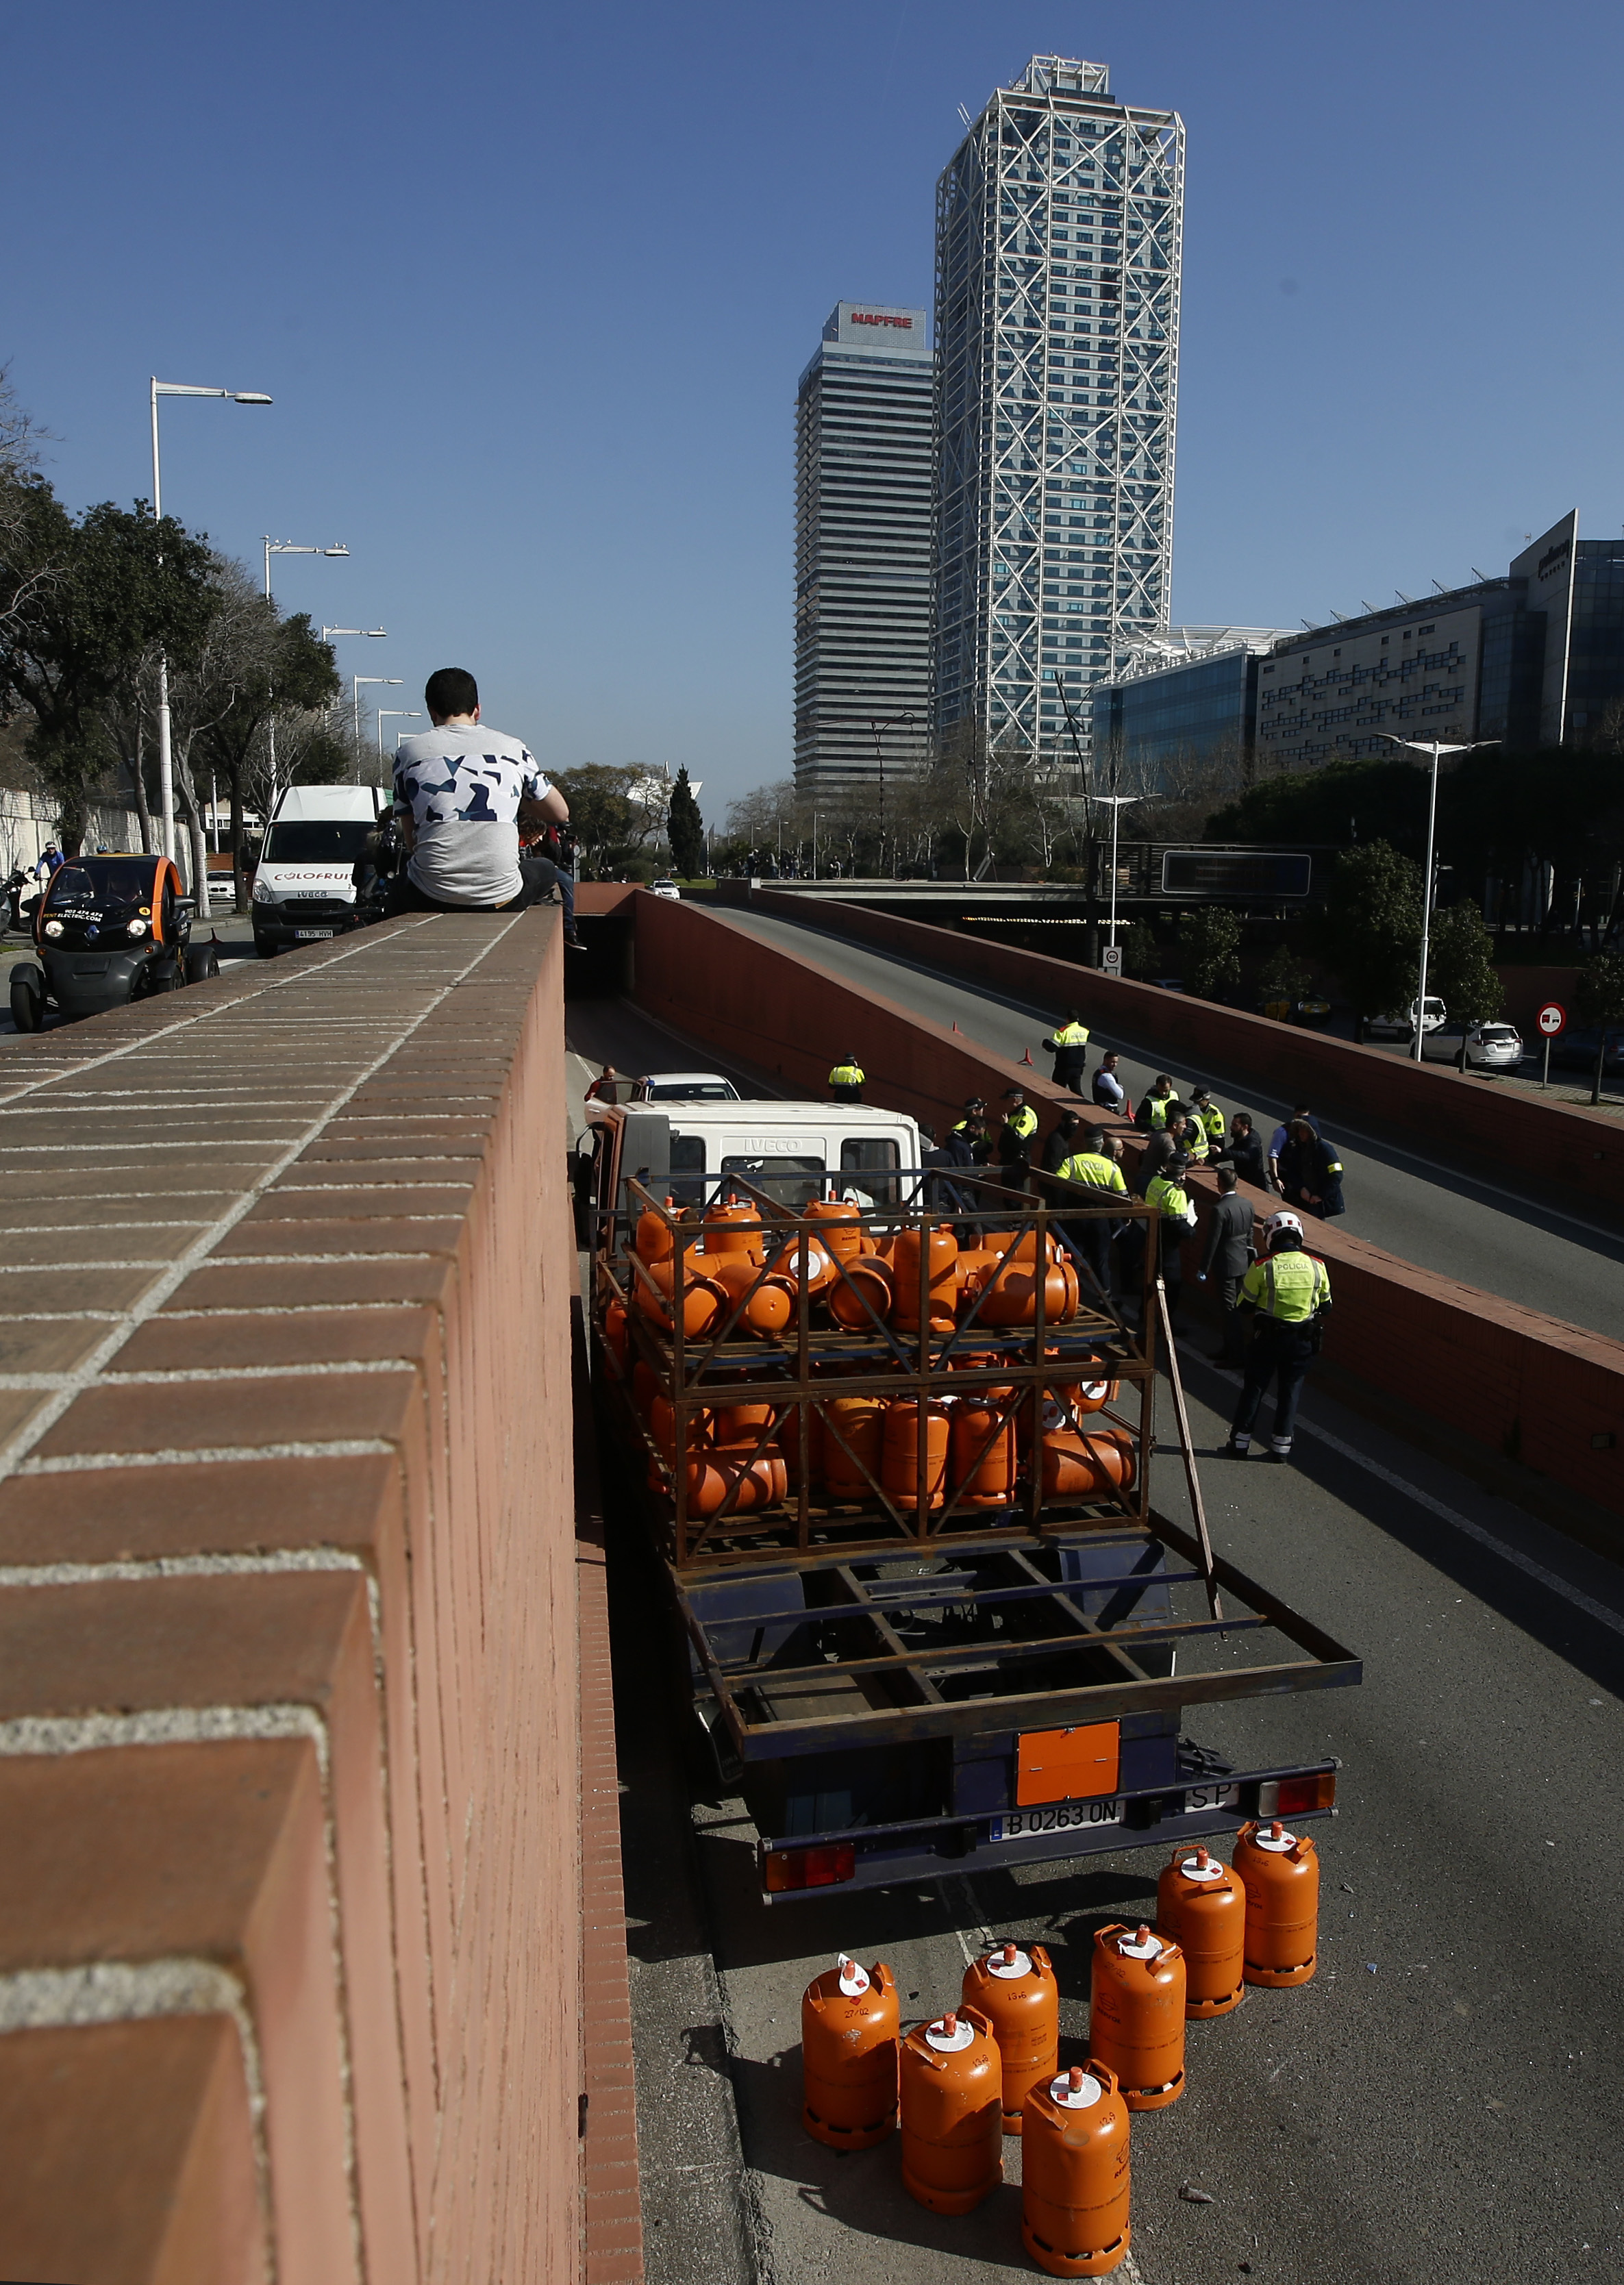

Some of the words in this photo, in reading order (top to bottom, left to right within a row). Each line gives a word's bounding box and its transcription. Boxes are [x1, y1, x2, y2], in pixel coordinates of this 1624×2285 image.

[851, 313, 912, 328] MAPFRE
[744, 1138, 801, 1152] IVECO
[1192, 1784, 1232, 1808] SP
[1029, 1806, 1084, 1832] 0263
[845, 2008, 870, 2019] 27/02
